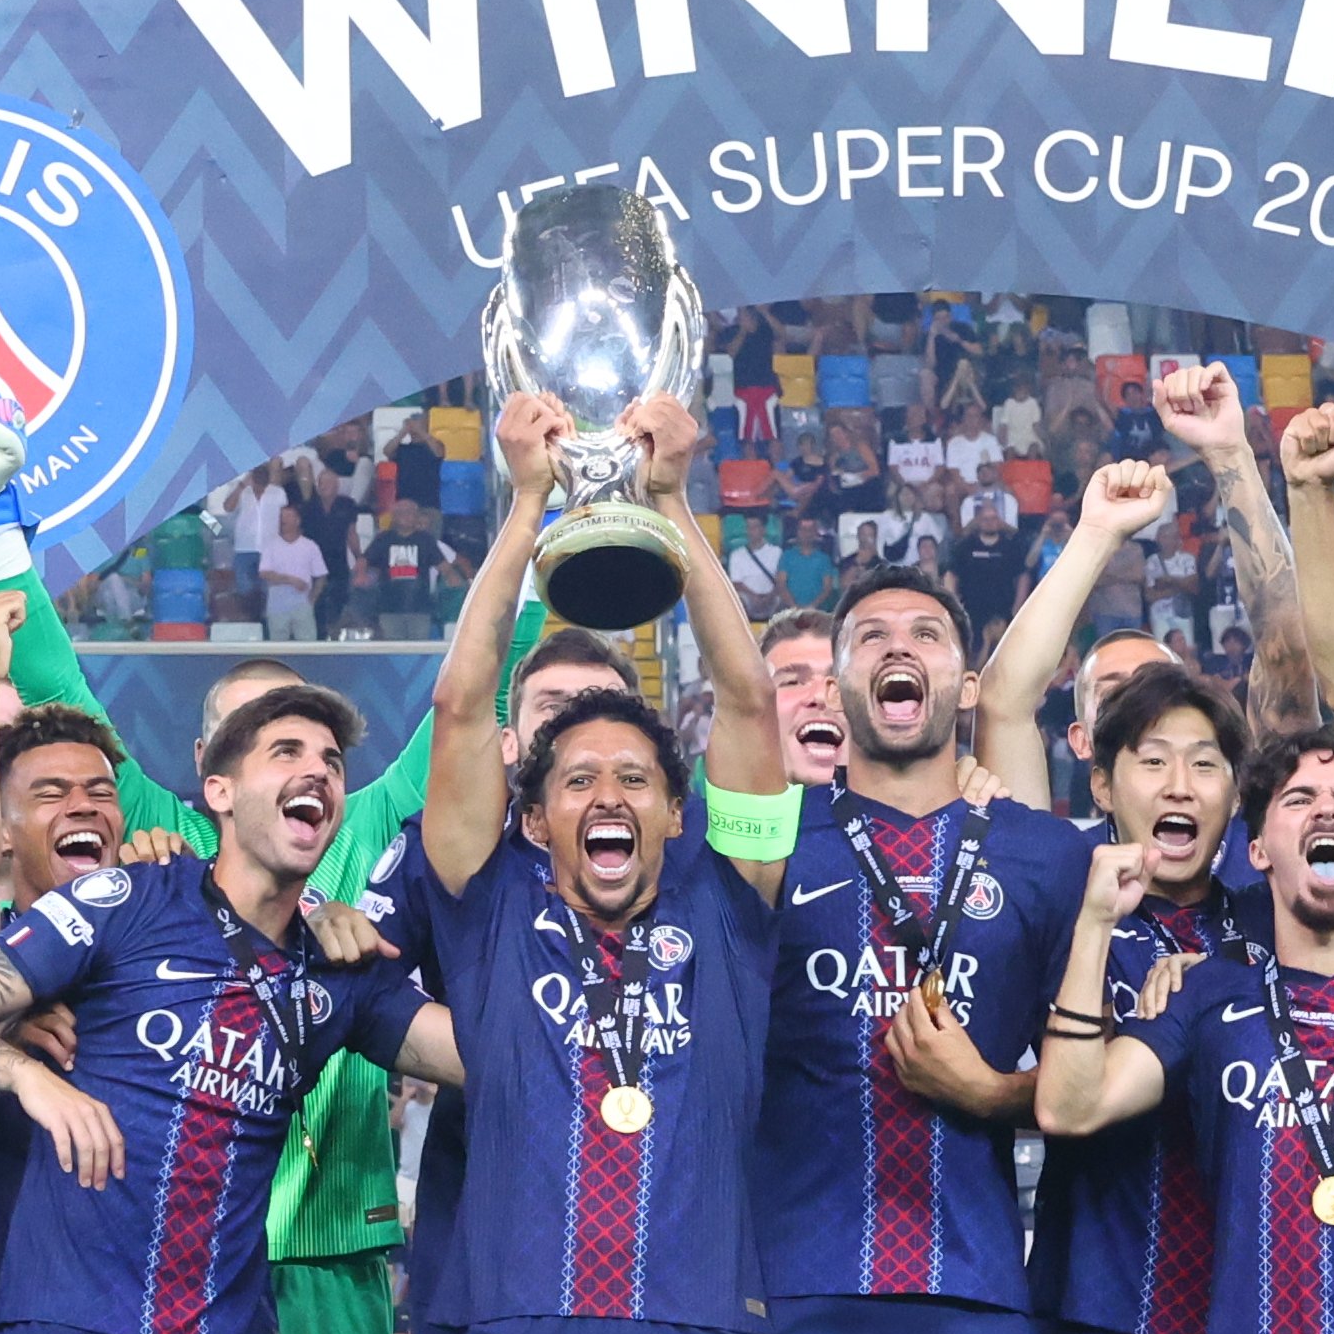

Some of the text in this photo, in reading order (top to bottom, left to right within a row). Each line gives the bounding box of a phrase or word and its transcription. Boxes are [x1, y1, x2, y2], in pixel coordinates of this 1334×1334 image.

[451, 155, 690, 269] UA
[710, 125, 1006, 216] SUPER
[1033, 130, 1234, 215] CUP
[805, 945, 979, 999] QATR
